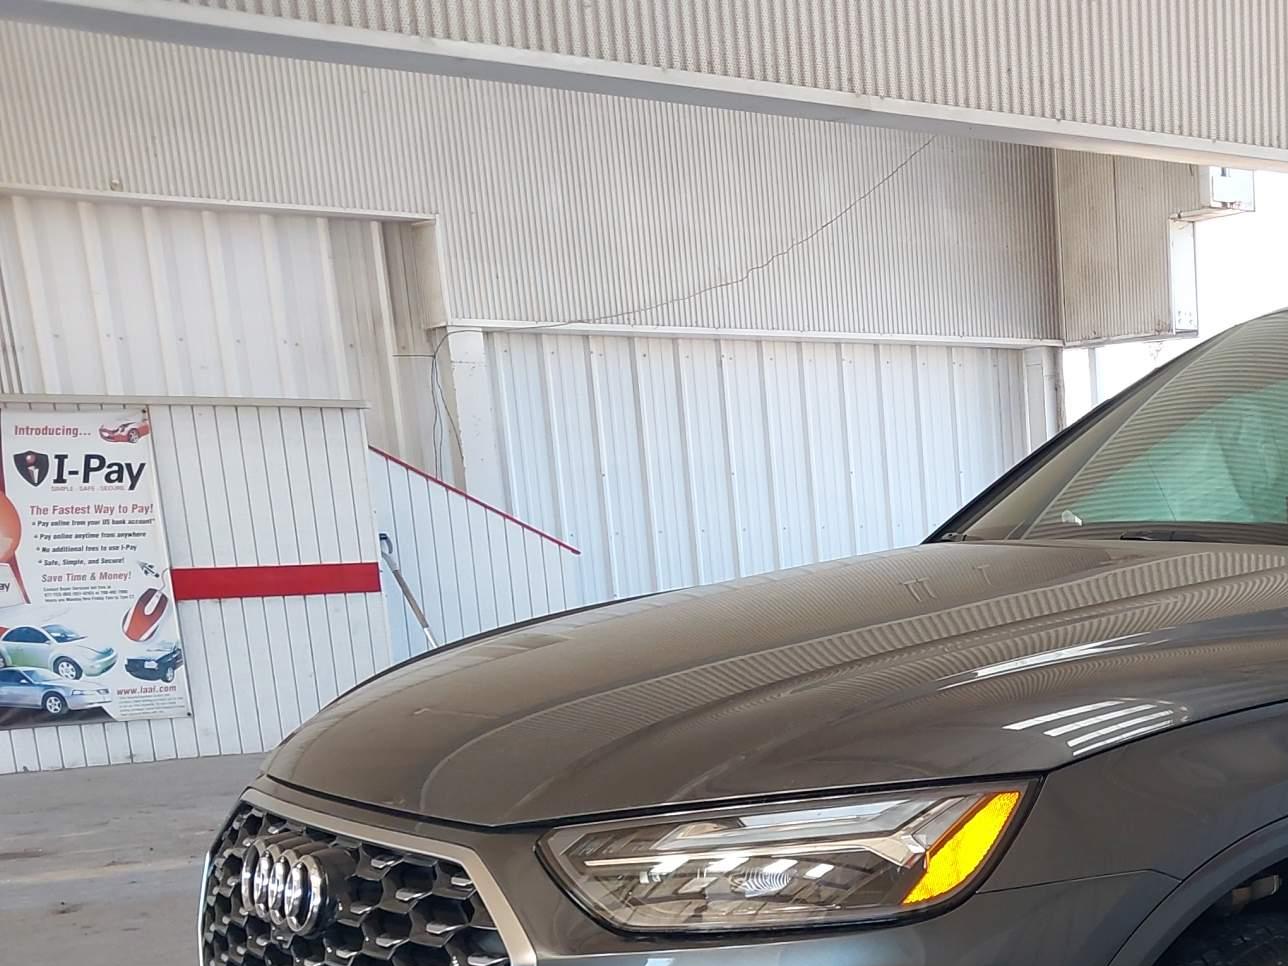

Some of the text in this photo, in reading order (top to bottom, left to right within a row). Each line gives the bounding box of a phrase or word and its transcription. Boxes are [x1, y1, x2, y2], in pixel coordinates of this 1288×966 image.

[14, 425, 91, 437] Introducing...
[52, 454, 147, 490] I-Pay
[30, 503, 154, 515] The Fastest Way to Pay!
[41, 571, 132, 583] Save Time & Money!
